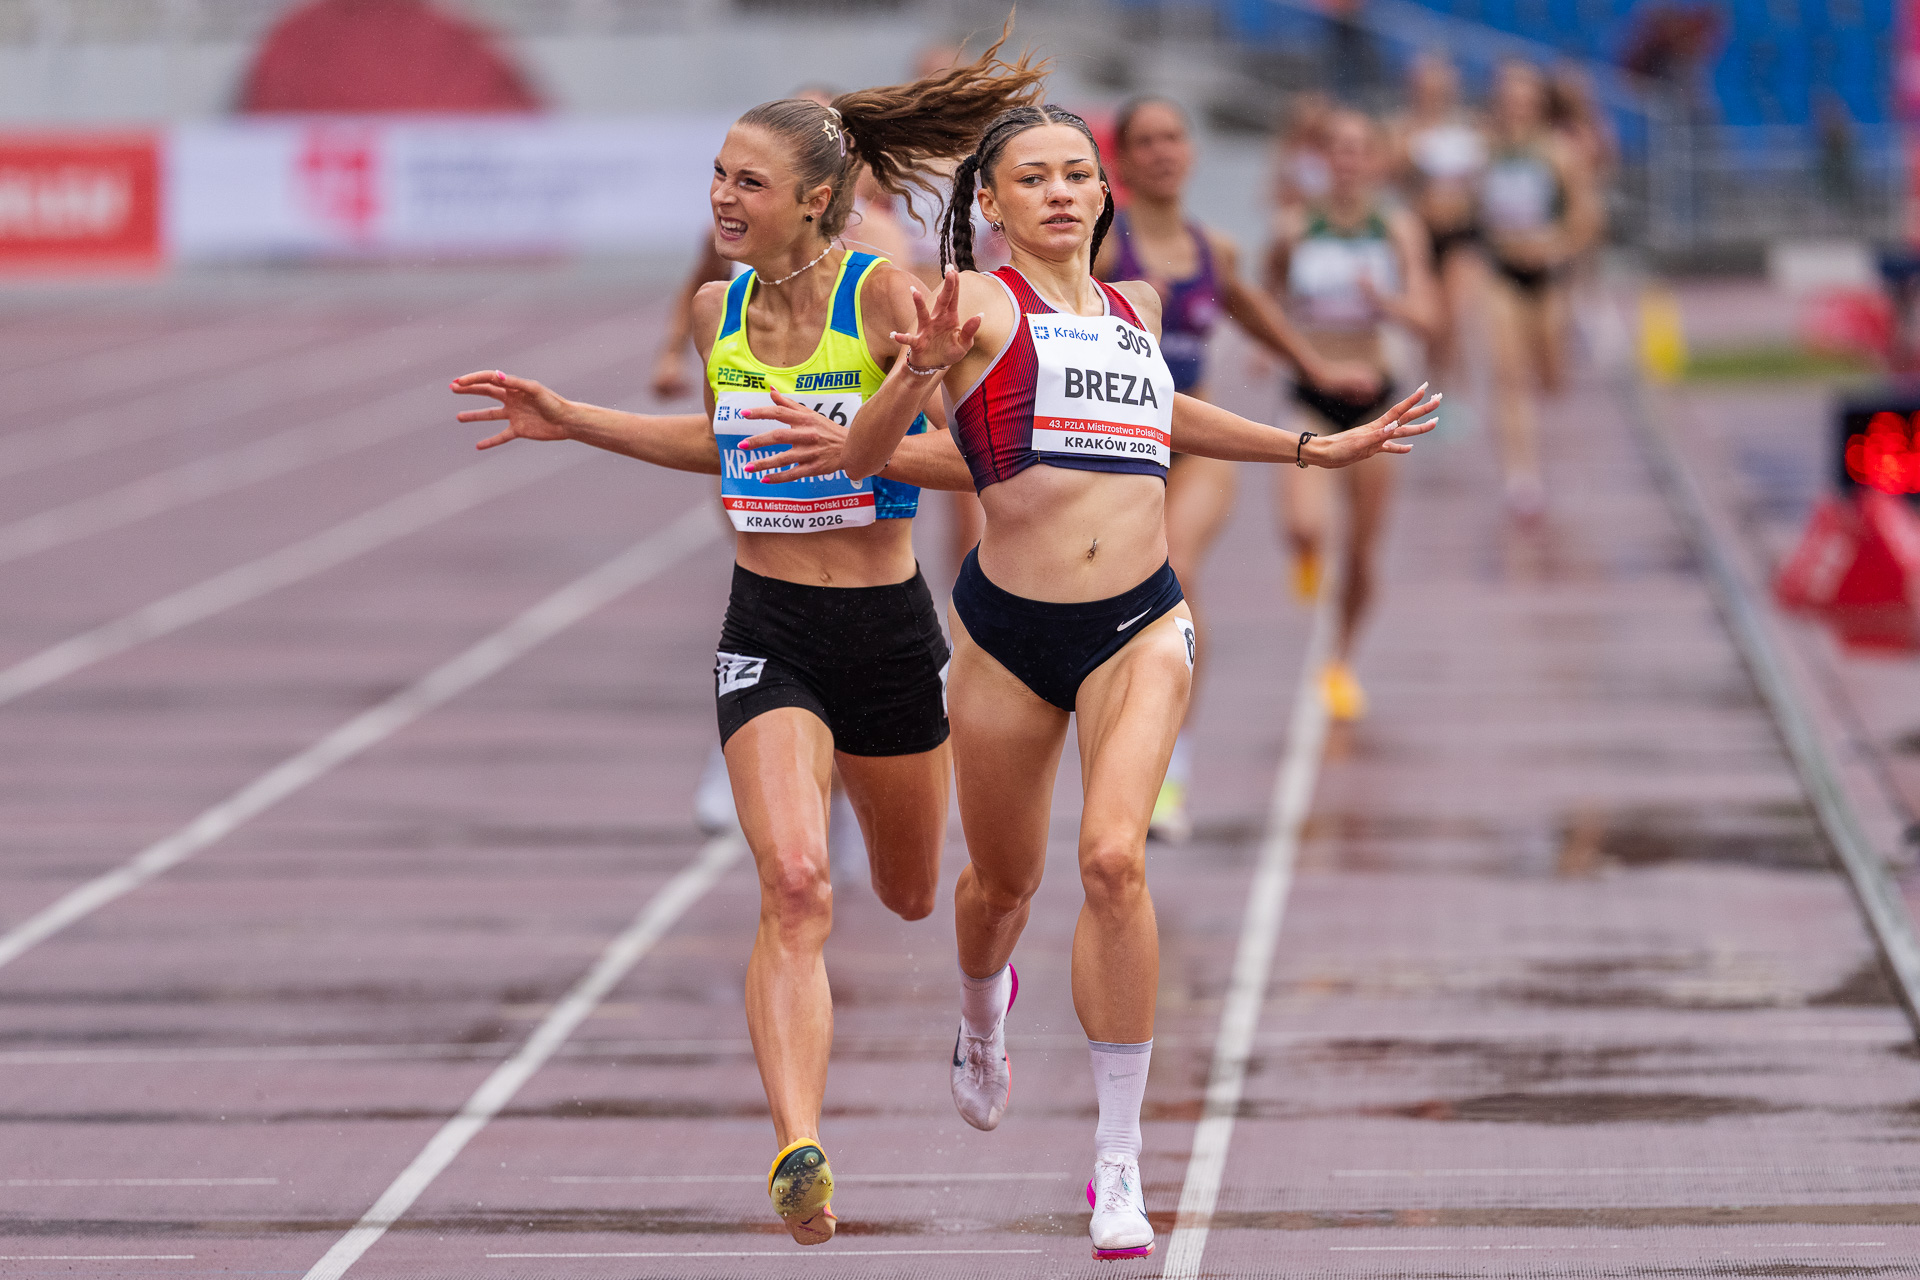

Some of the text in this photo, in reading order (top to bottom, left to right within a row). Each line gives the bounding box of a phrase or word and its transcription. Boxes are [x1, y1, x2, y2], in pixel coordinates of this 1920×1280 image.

[1054, 327, 1099, 342] Kraków
[1116, 324, 1151, 358] 309
[795, 370, 862, 391] SONAROL
[1064, 367, 1158, 409] BREZA
[1049, 419, 1062, 429] 43.
[1064, 421, 1085, 430] PZLA
[1087, 422, 1134, 435] Mistrzostwa
[1135, 427, 1156, 438] Polski
[1064, 436, 1157, 456] KRAKÓW 2026
[732, 498, 859, 512] 43. PZLA Mistrzostwa Polski U23
[746, 514, 843, 528] KRAKÓW 2026
